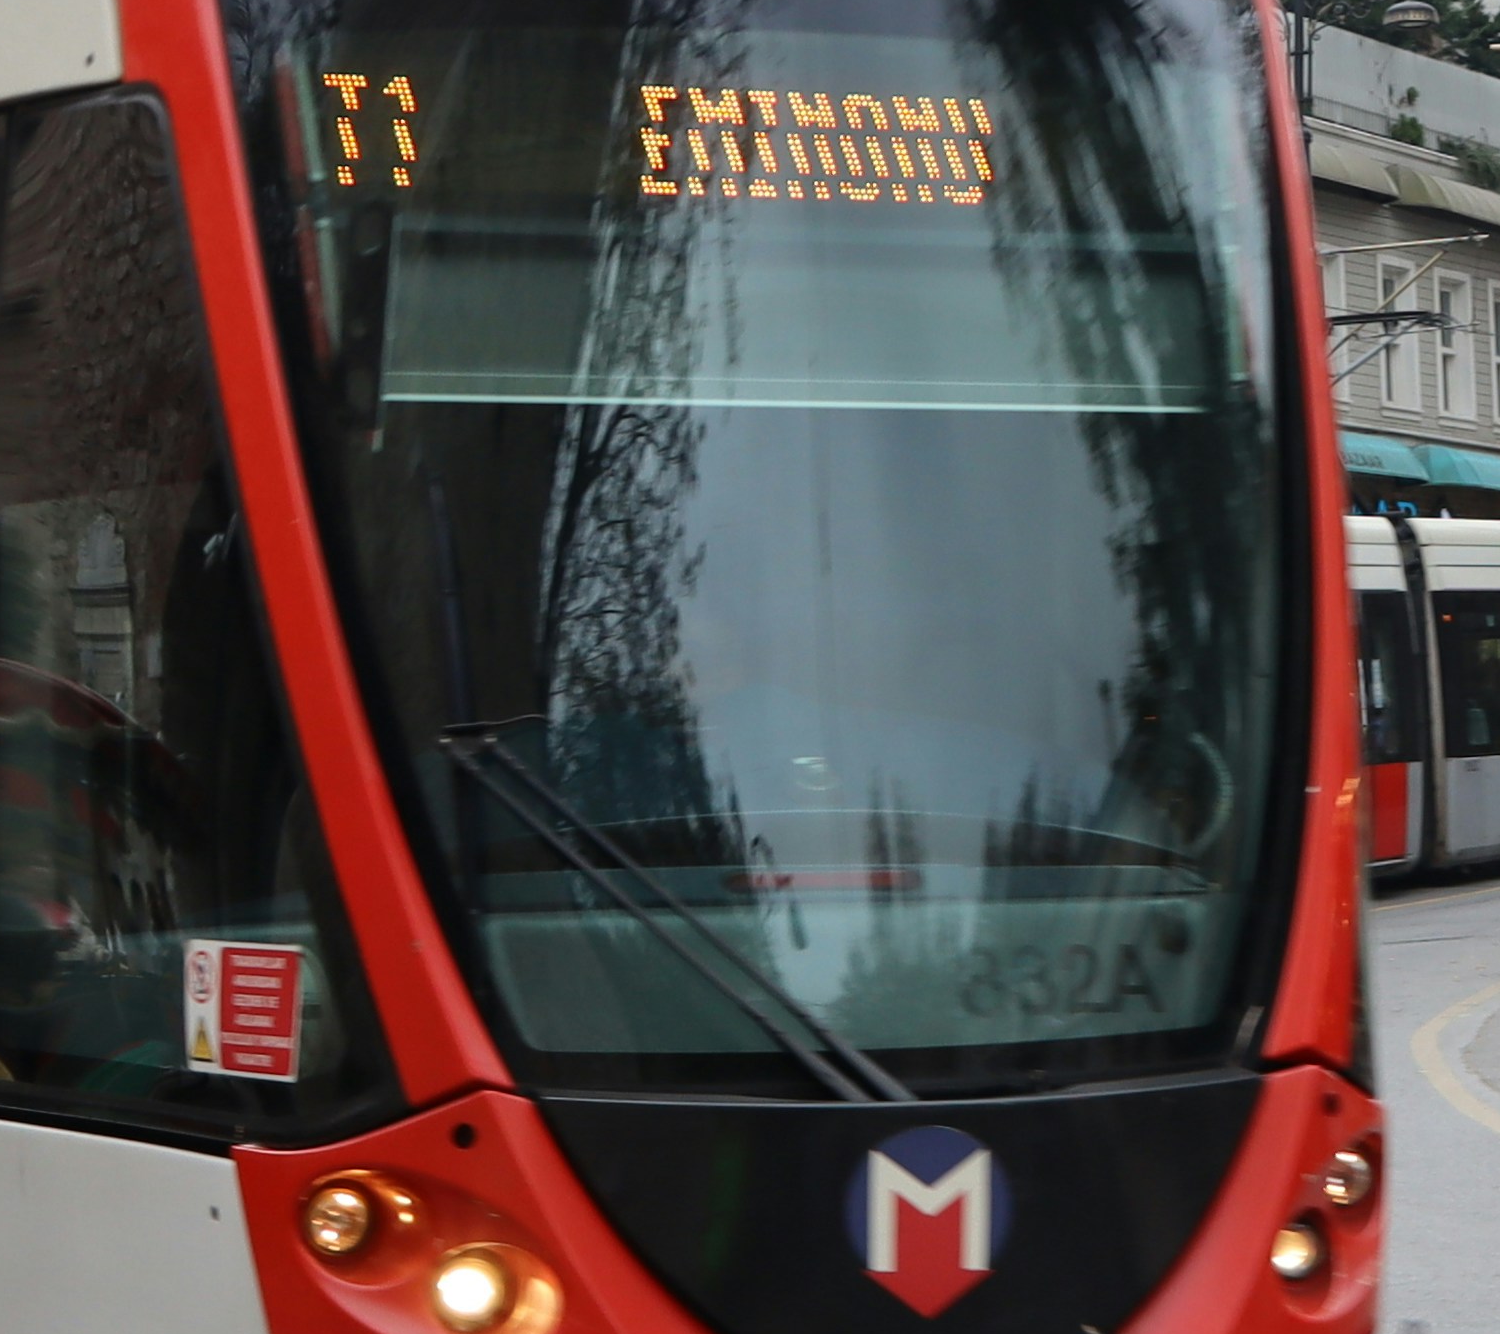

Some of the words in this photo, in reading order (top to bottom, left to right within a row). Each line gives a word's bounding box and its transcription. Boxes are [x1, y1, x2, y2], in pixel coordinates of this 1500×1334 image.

[323, 73, 419, 187] T1
[958, 943, 1167, 1016] 832A
[866, 1147, 992, 1273] M
